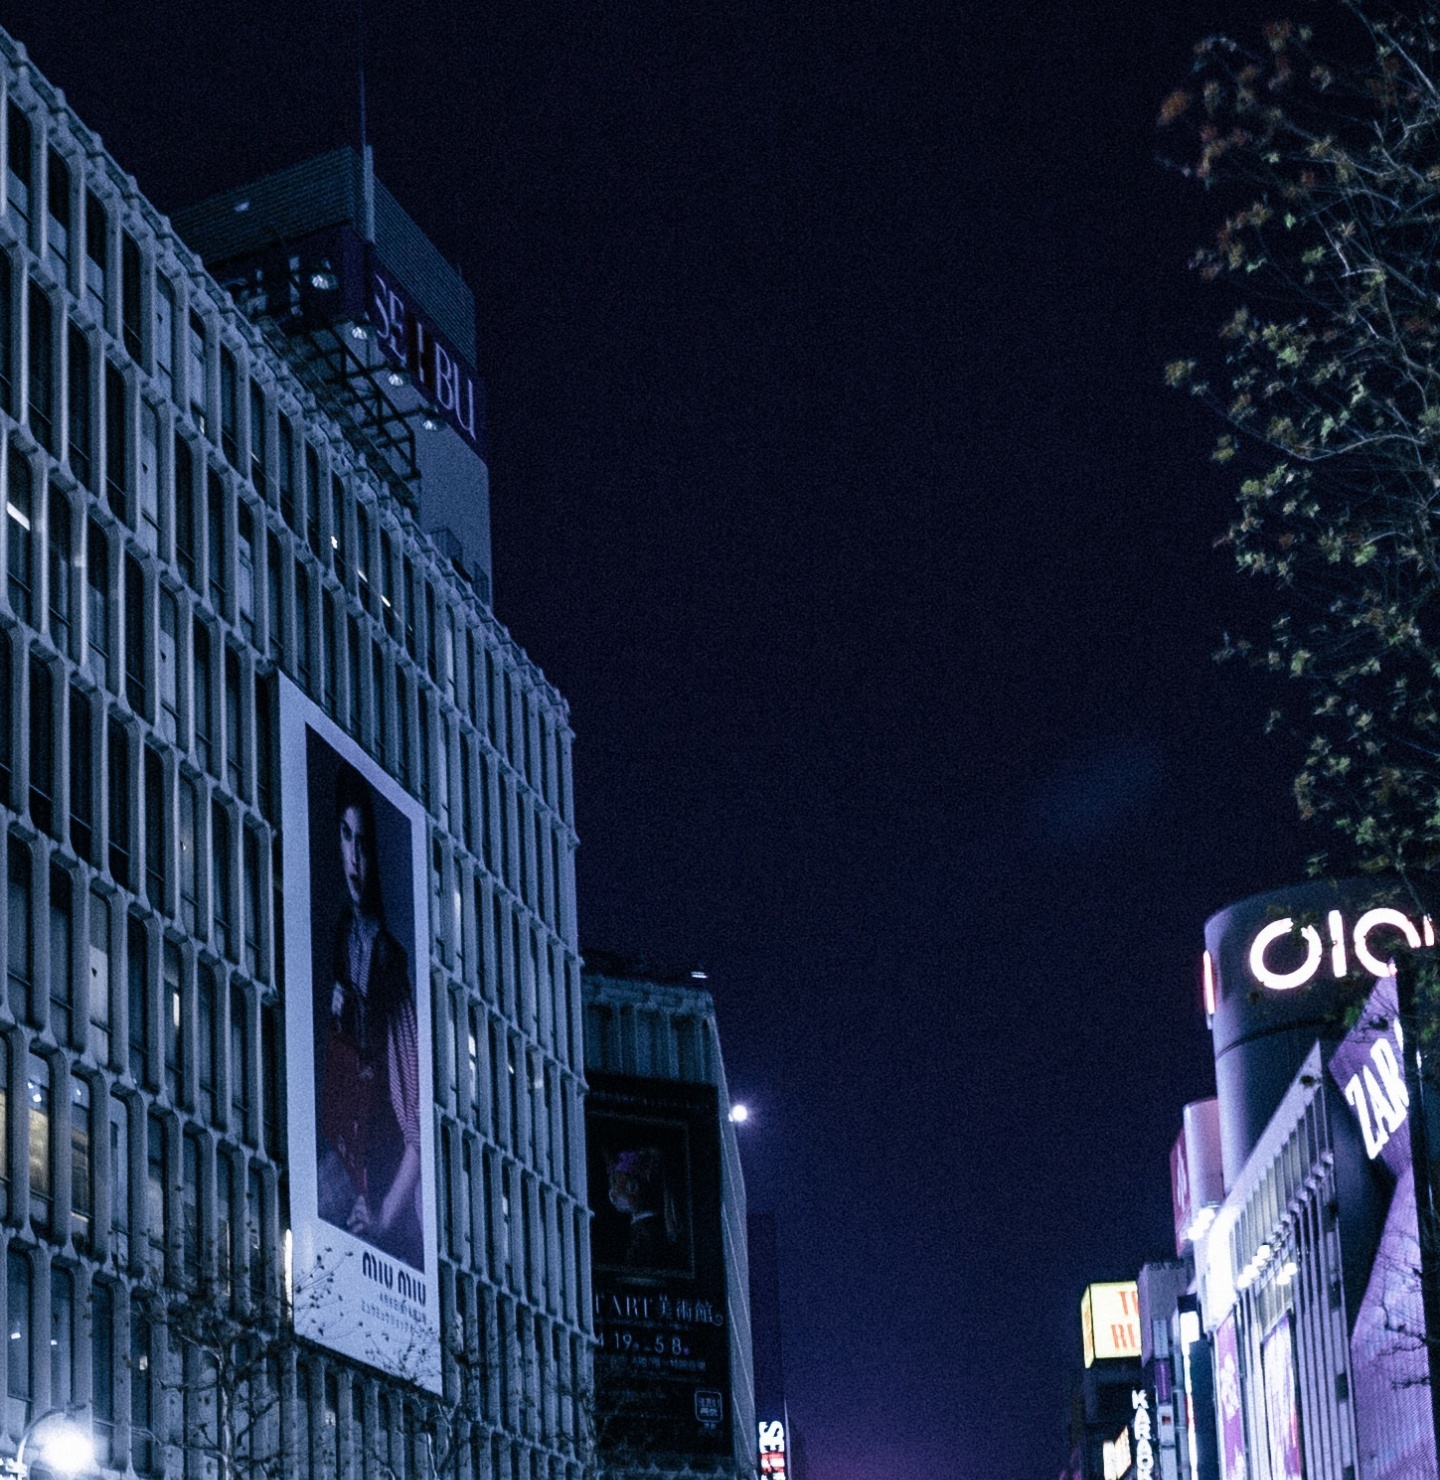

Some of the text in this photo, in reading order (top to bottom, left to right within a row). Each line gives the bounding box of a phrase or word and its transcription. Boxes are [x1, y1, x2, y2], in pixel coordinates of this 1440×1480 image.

[1344, 1017, 1410, 1161] ZAR
[362, 1250, 394, 1291] MIU
[397, 1269, 427, 1309] MIU
